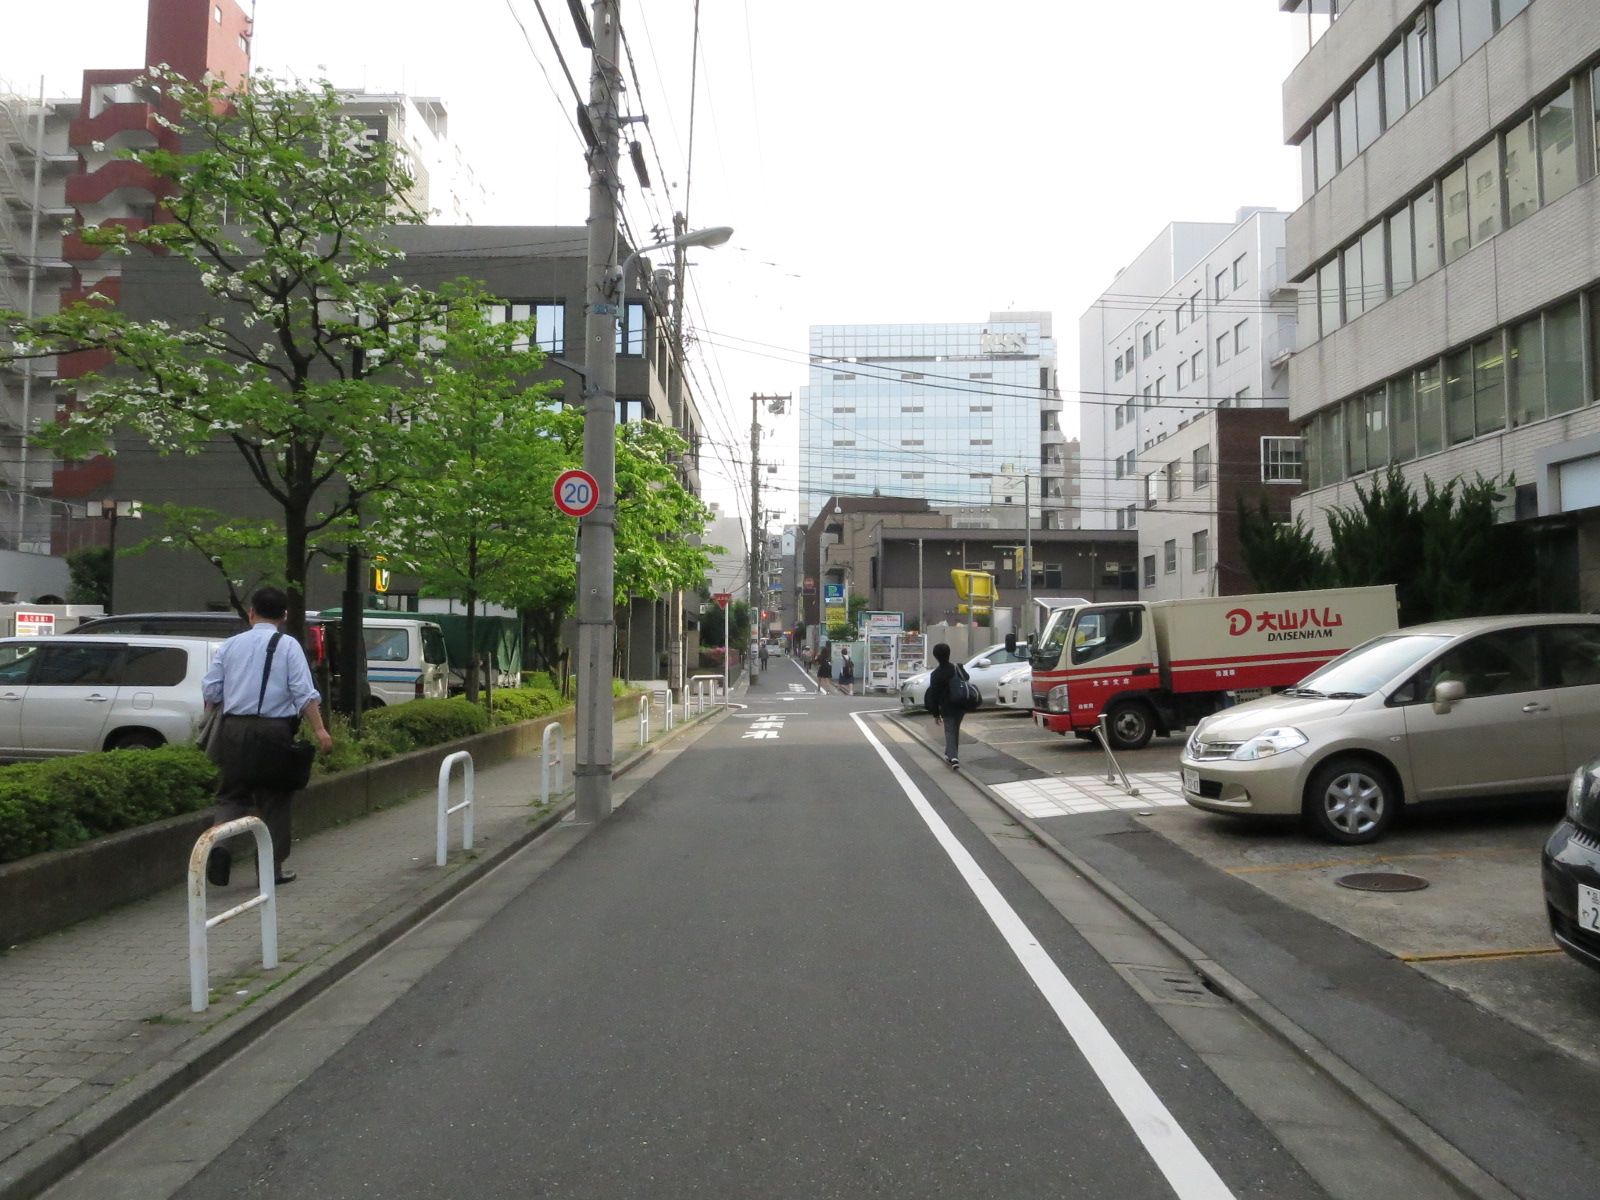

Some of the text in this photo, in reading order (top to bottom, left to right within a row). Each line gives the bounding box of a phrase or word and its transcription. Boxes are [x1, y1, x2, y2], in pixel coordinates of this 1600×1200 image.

[565, 483, 589, 504] 20
[1256, 607, 1344, 632] 大山ハム
[1267, 629, 1333, 642] DAISENHAM
